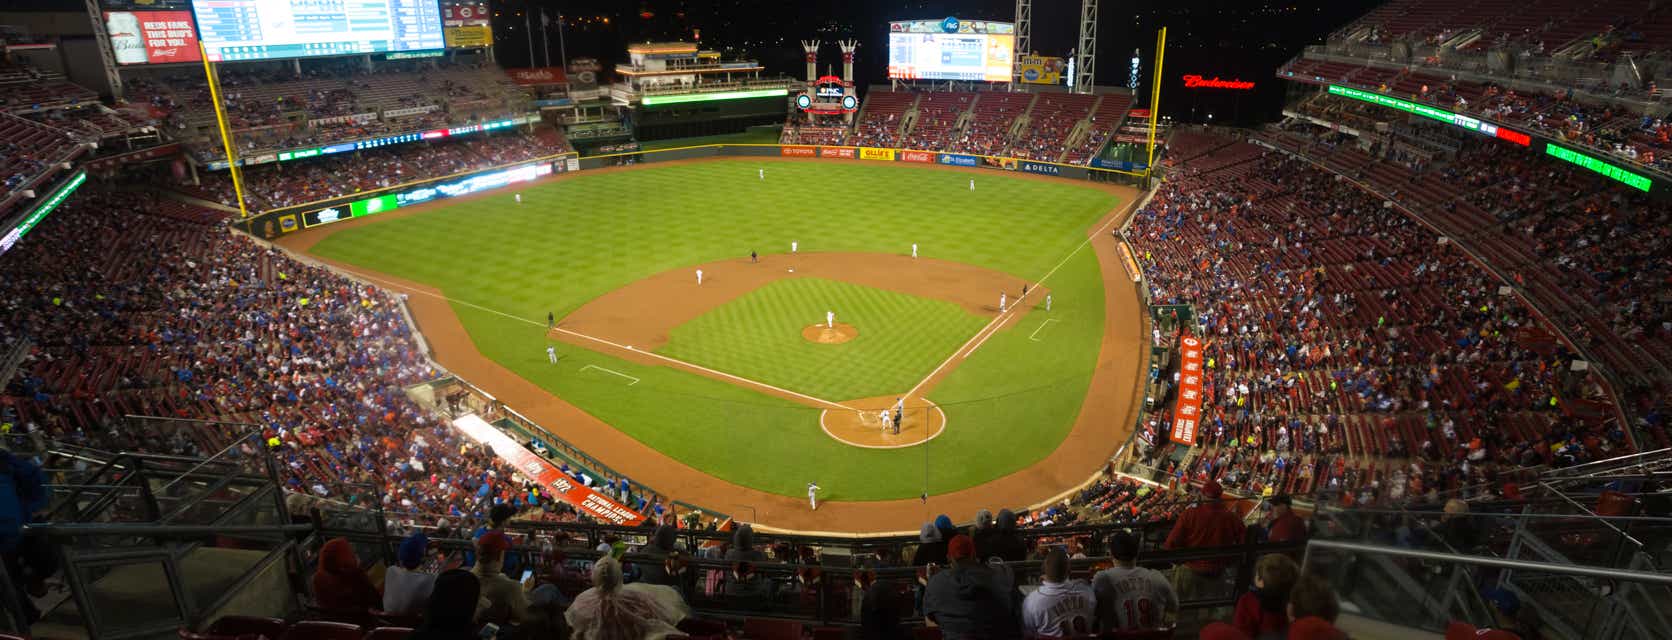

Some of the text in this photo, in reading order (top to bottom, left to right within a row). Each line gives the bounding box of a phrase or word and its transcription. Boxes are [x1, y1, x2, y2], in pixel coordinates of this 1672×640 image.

[144, 22, 166, 30] REDS
[146, 30, 166, 38] THIS
[148, 39, 166, 47] FOR
[1183, 74, 1255, 89] Budweiser
[1032, 164, 1058, 174] DELTA
[582, 500, 626, 524] CHAMPIONS
[586, 493, 638, 520] NATIONAL LEAGUE
[1123, 598, 1151, 627] 19
